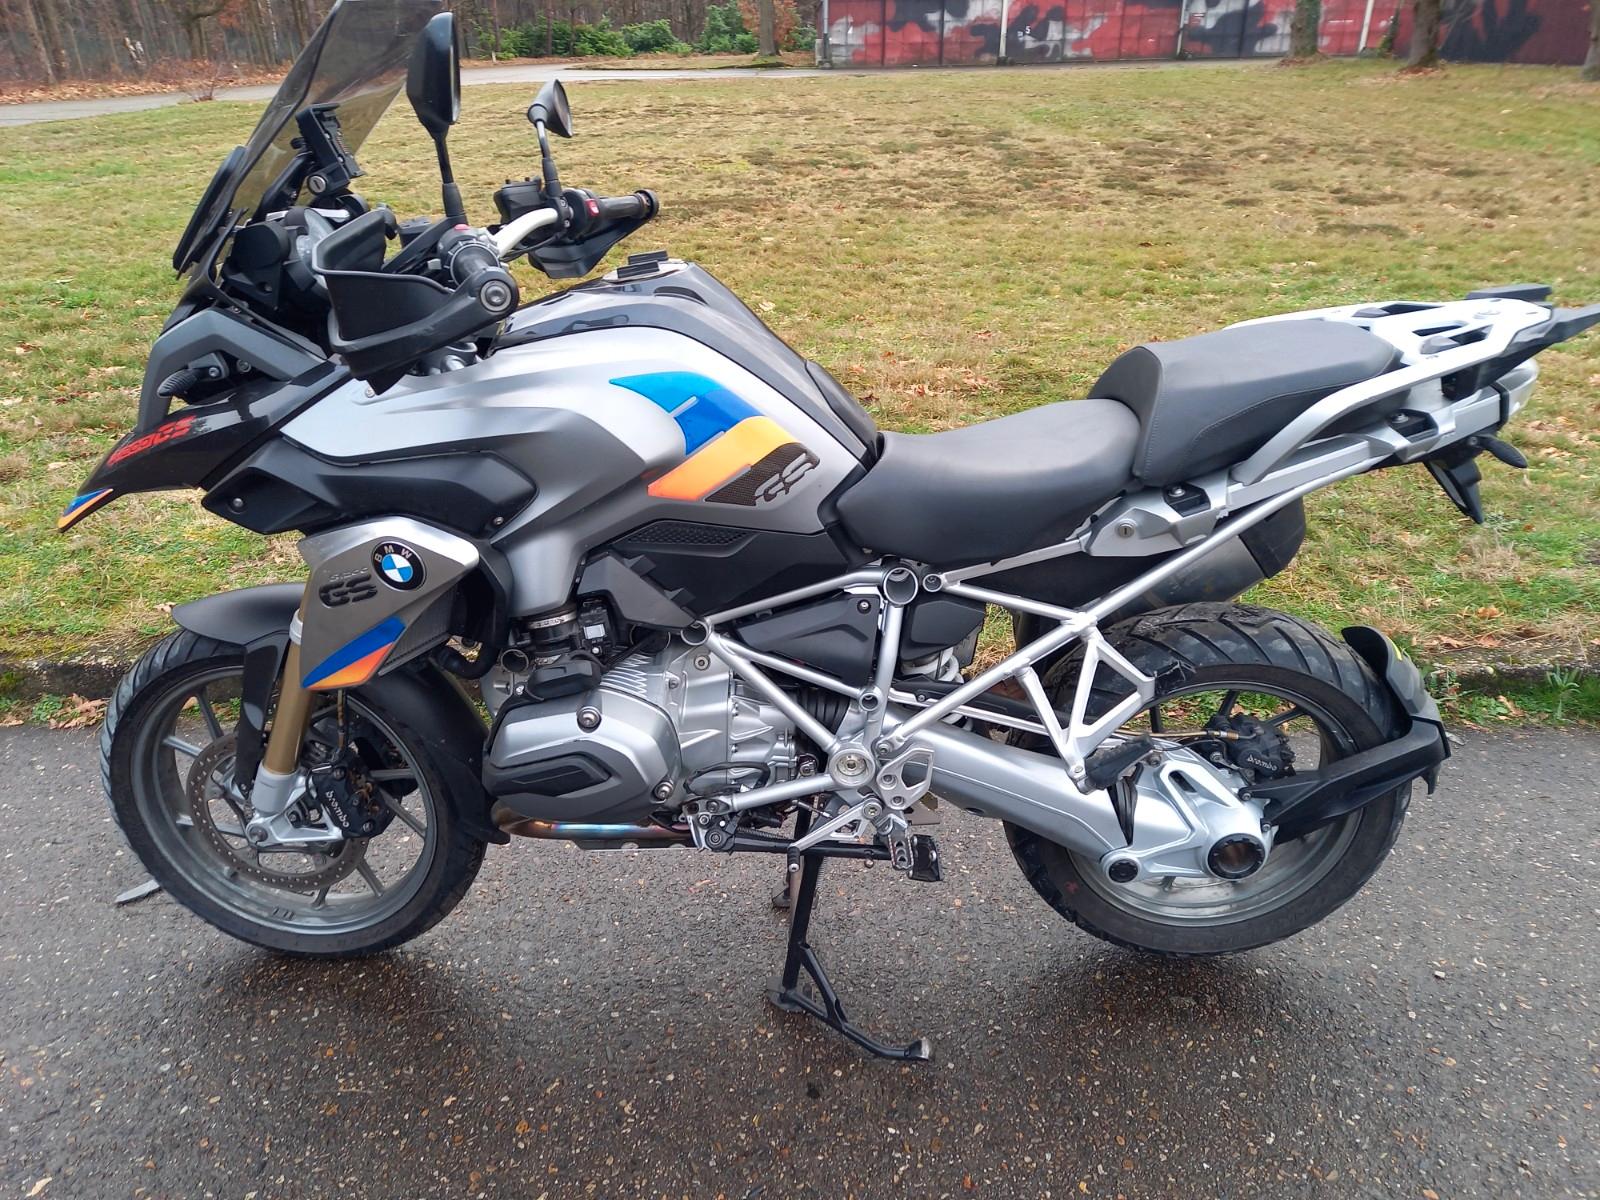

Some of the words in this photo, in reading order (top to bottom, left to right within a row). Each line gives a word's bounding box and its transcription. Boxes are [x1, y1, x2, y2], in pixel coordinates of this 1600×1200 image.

[754, 452, 813, 506] GS
[374, 545, 412, 563] BMW
[319, 573, 378, 607] GS
[1247, 754, 1278, 771] brembo
[326, 790, 350, 828] brembo
